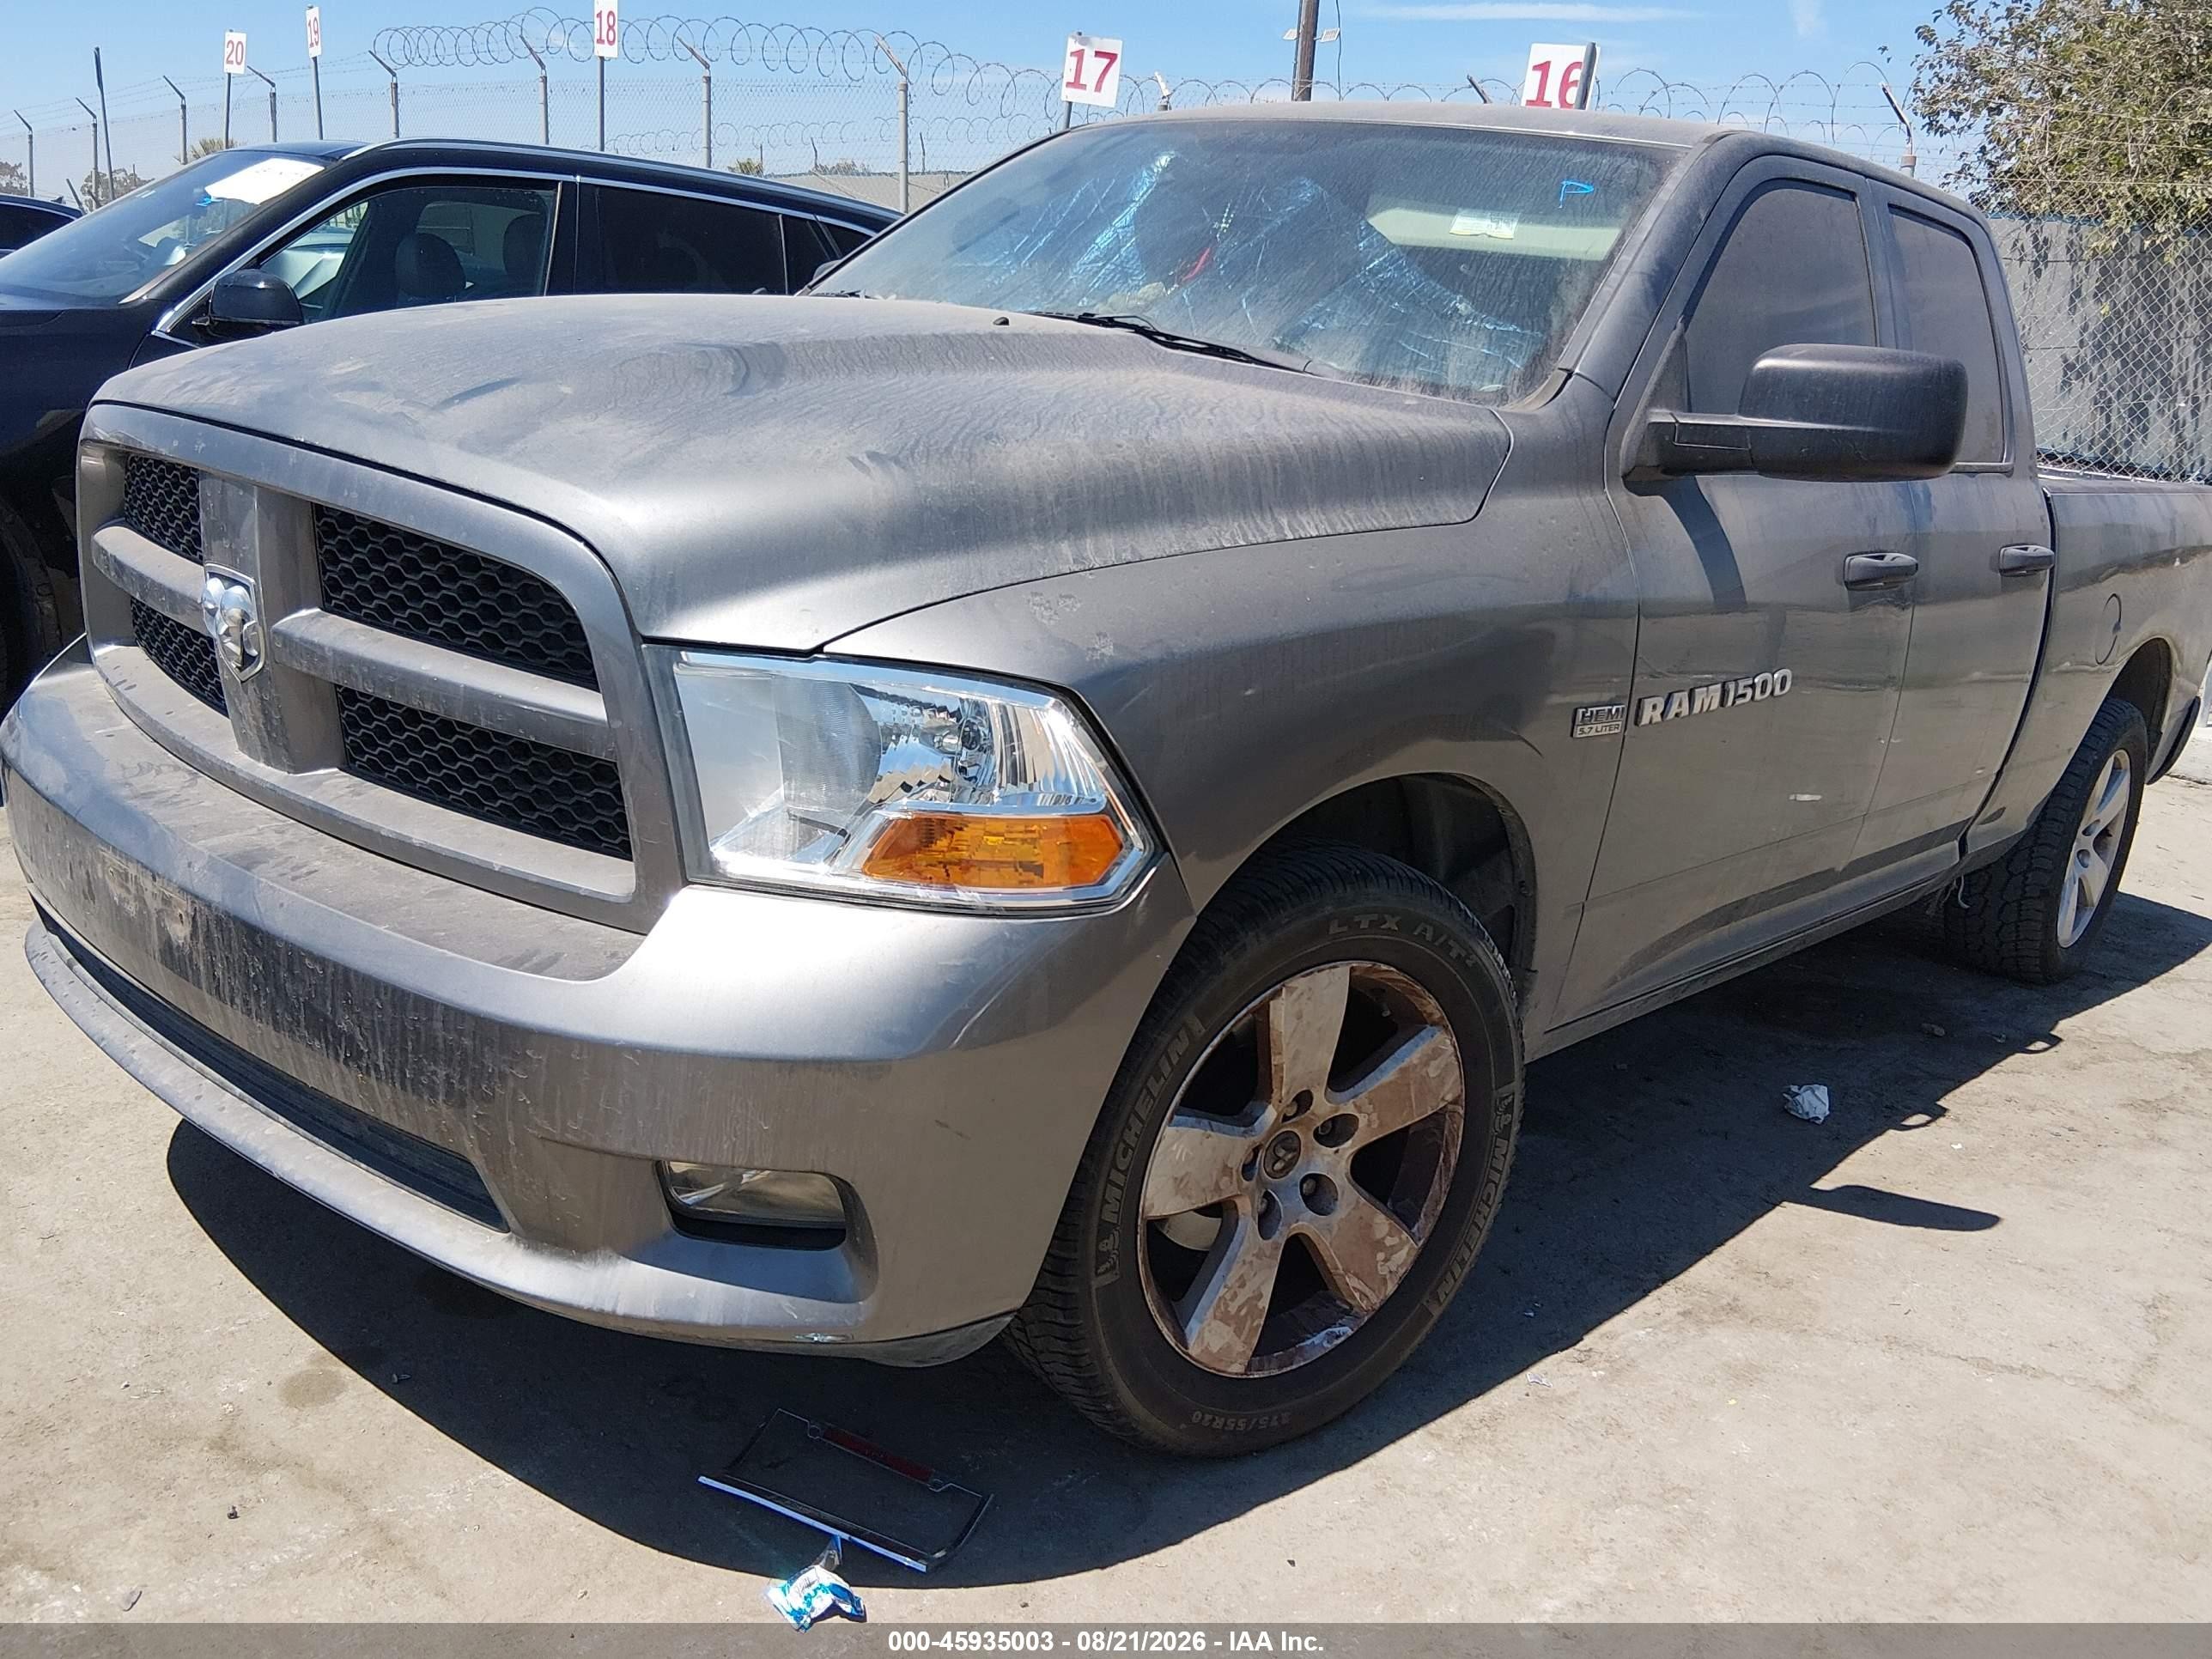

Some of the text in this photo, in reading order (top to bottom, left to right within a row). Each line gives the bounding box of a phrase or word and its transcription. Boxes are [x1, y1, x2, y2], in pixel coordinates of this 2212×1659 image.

[307, 16, 320, 48] 19
[595, 10, 617, 46] 18
[225, 40, 245, 66] 20
[1066, 48, 1119, 93] 17
[1526, 60, 1582, 109] 16
[1579, 705, 1626, 726] HEMI
[1638, 668, 1794, 727] RAM 1500
[1578, 723, 1620, 736] 5.7 LITER
[1328, 913, 1402, 935] LTX
[1100, 1025, 1191, 1224] MICHELIN
[1435, 1137, 1509, 1306] MICHELIN
